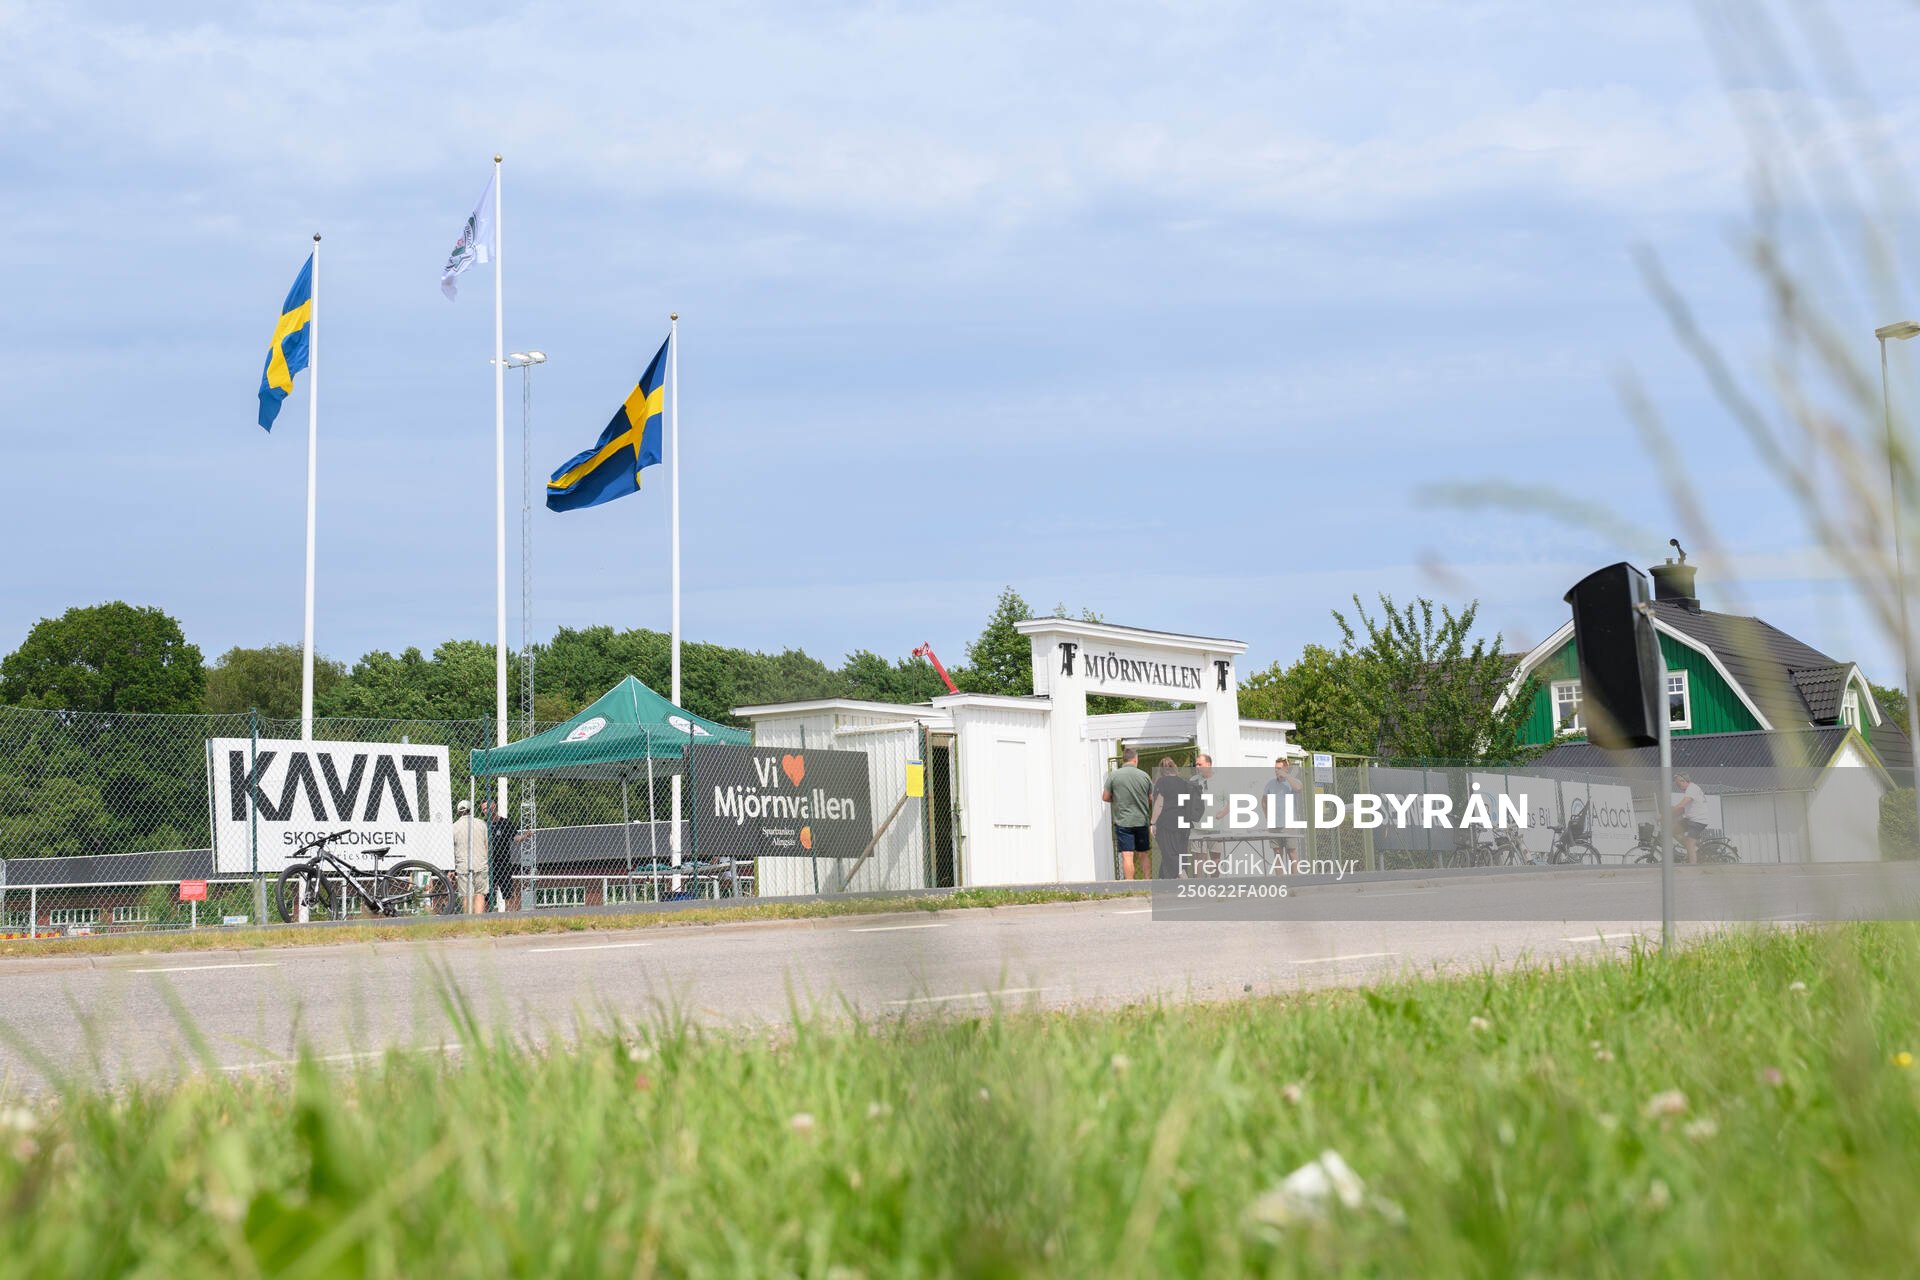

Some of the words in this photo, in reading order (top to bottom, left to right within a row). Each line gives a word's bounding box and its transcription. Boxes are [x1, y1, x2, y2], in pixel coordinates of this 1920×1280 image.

[1083, 652, 1201, 688] MJÖRNVALLEN
[229, 751, 439, 822] KAVAT
[753, 756, 779, 789] Vi
[714, 785, 855, 825] Mjörnvallen
[1591, 800, 1633, 829] Adact
